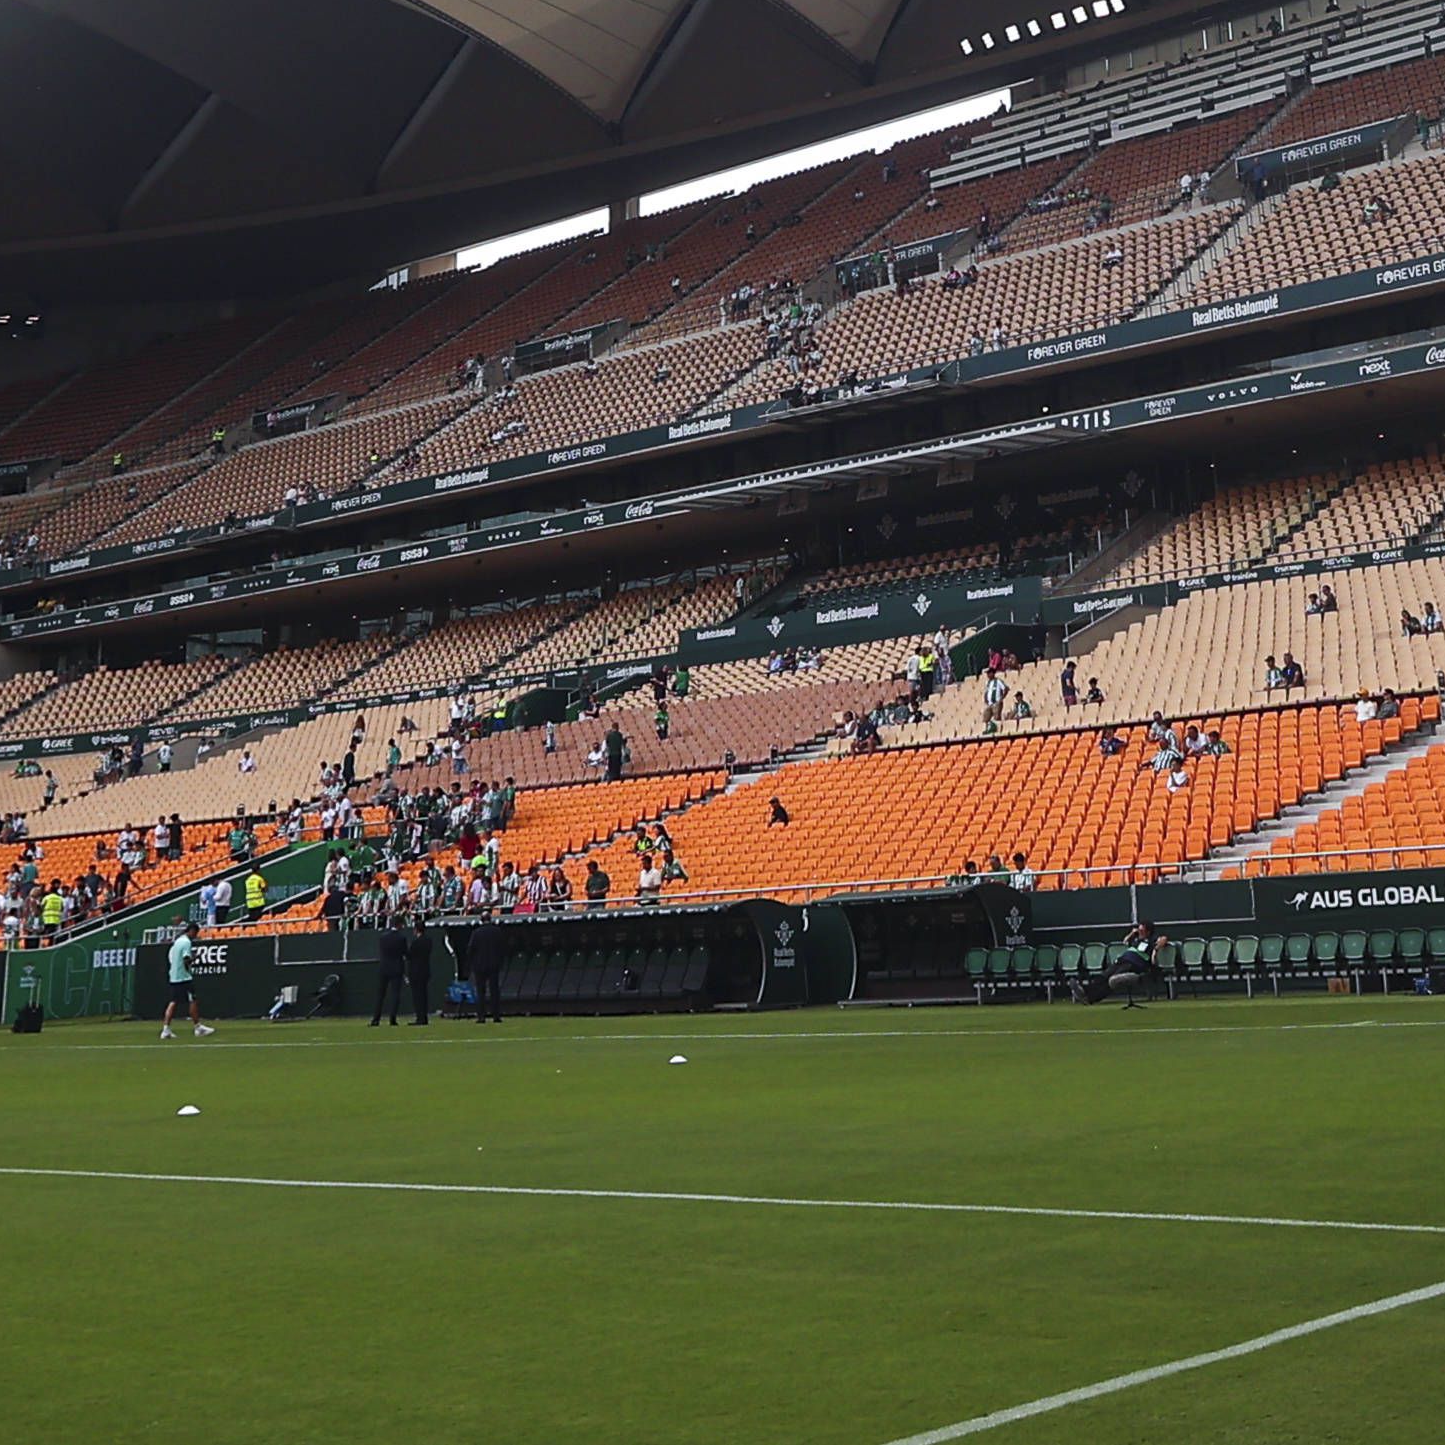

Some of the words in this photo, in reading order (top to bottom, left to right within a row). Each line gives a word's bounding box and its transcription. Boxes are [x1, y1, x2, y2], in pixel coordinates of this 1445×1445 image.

[1282, 142, 1327, 162] FOREVER
[1329, 134, 1361, 153] GREEN
[1376, 262, 1430, 285] FOREVER
[1193, 311, 1212, 327] Real
[1213, 305, 1234, 323] Betis
[1235, 295, 1278, 317] Balompié
[1028, 342, 1072, 361] FOREVER
[1075, 334, 1106, 353] GREEN
[1359, 360, 1390, 376] next
[1207, 386, 1258, 402] VOLVO
[548, 450, 581, 464] FOREVER
[583, 444, 606, 458] GREEN
[1310, 888, 1353, 909] AUS
[1357, 884, 1445, 908] GLOBAL
